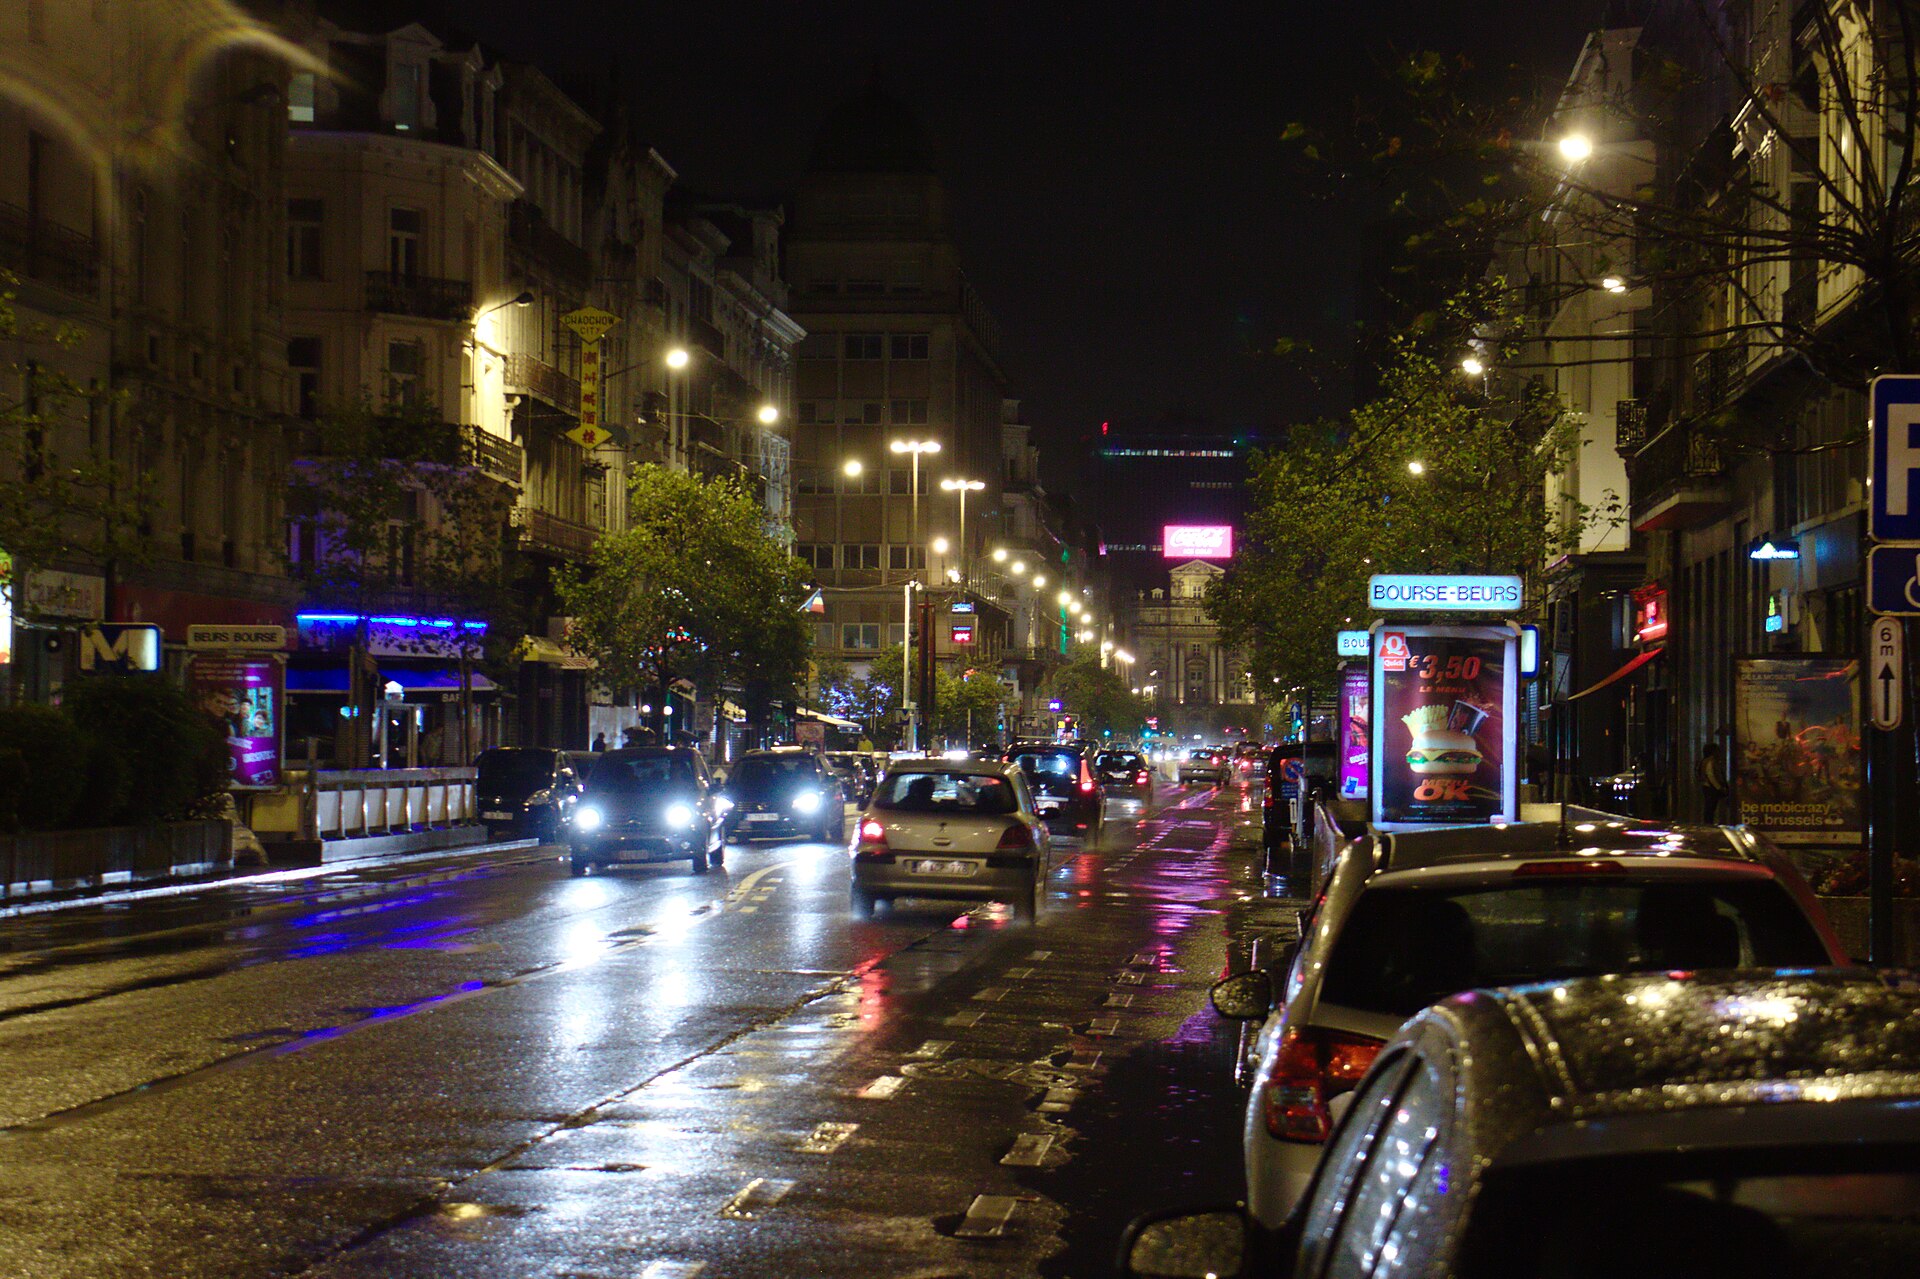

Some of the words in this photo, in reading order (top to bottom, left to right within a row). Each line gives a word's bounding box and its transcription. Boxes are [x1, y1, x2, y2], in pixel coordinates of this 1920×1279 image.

[564, 315, 616, 325] CHAOCHOW
[580, 326, 601, 336] CITY
[1374, 585, 1518, 601] BOURSE-BEURS
[193, 632, 229, 642] BEURS
[233, 632, 277, 642] BOURSE
[1880, 627, 1892, 642] 6
[80, 629, 157, 670] M
[1880, 645, 1893, 656] m
[1384, 659, 1403, 667] Quick
[1413, 785, 1470, 801] OK
[1741, 800, 1759, 813] be
[1760, 801, 1830, 815] mobicrazy
